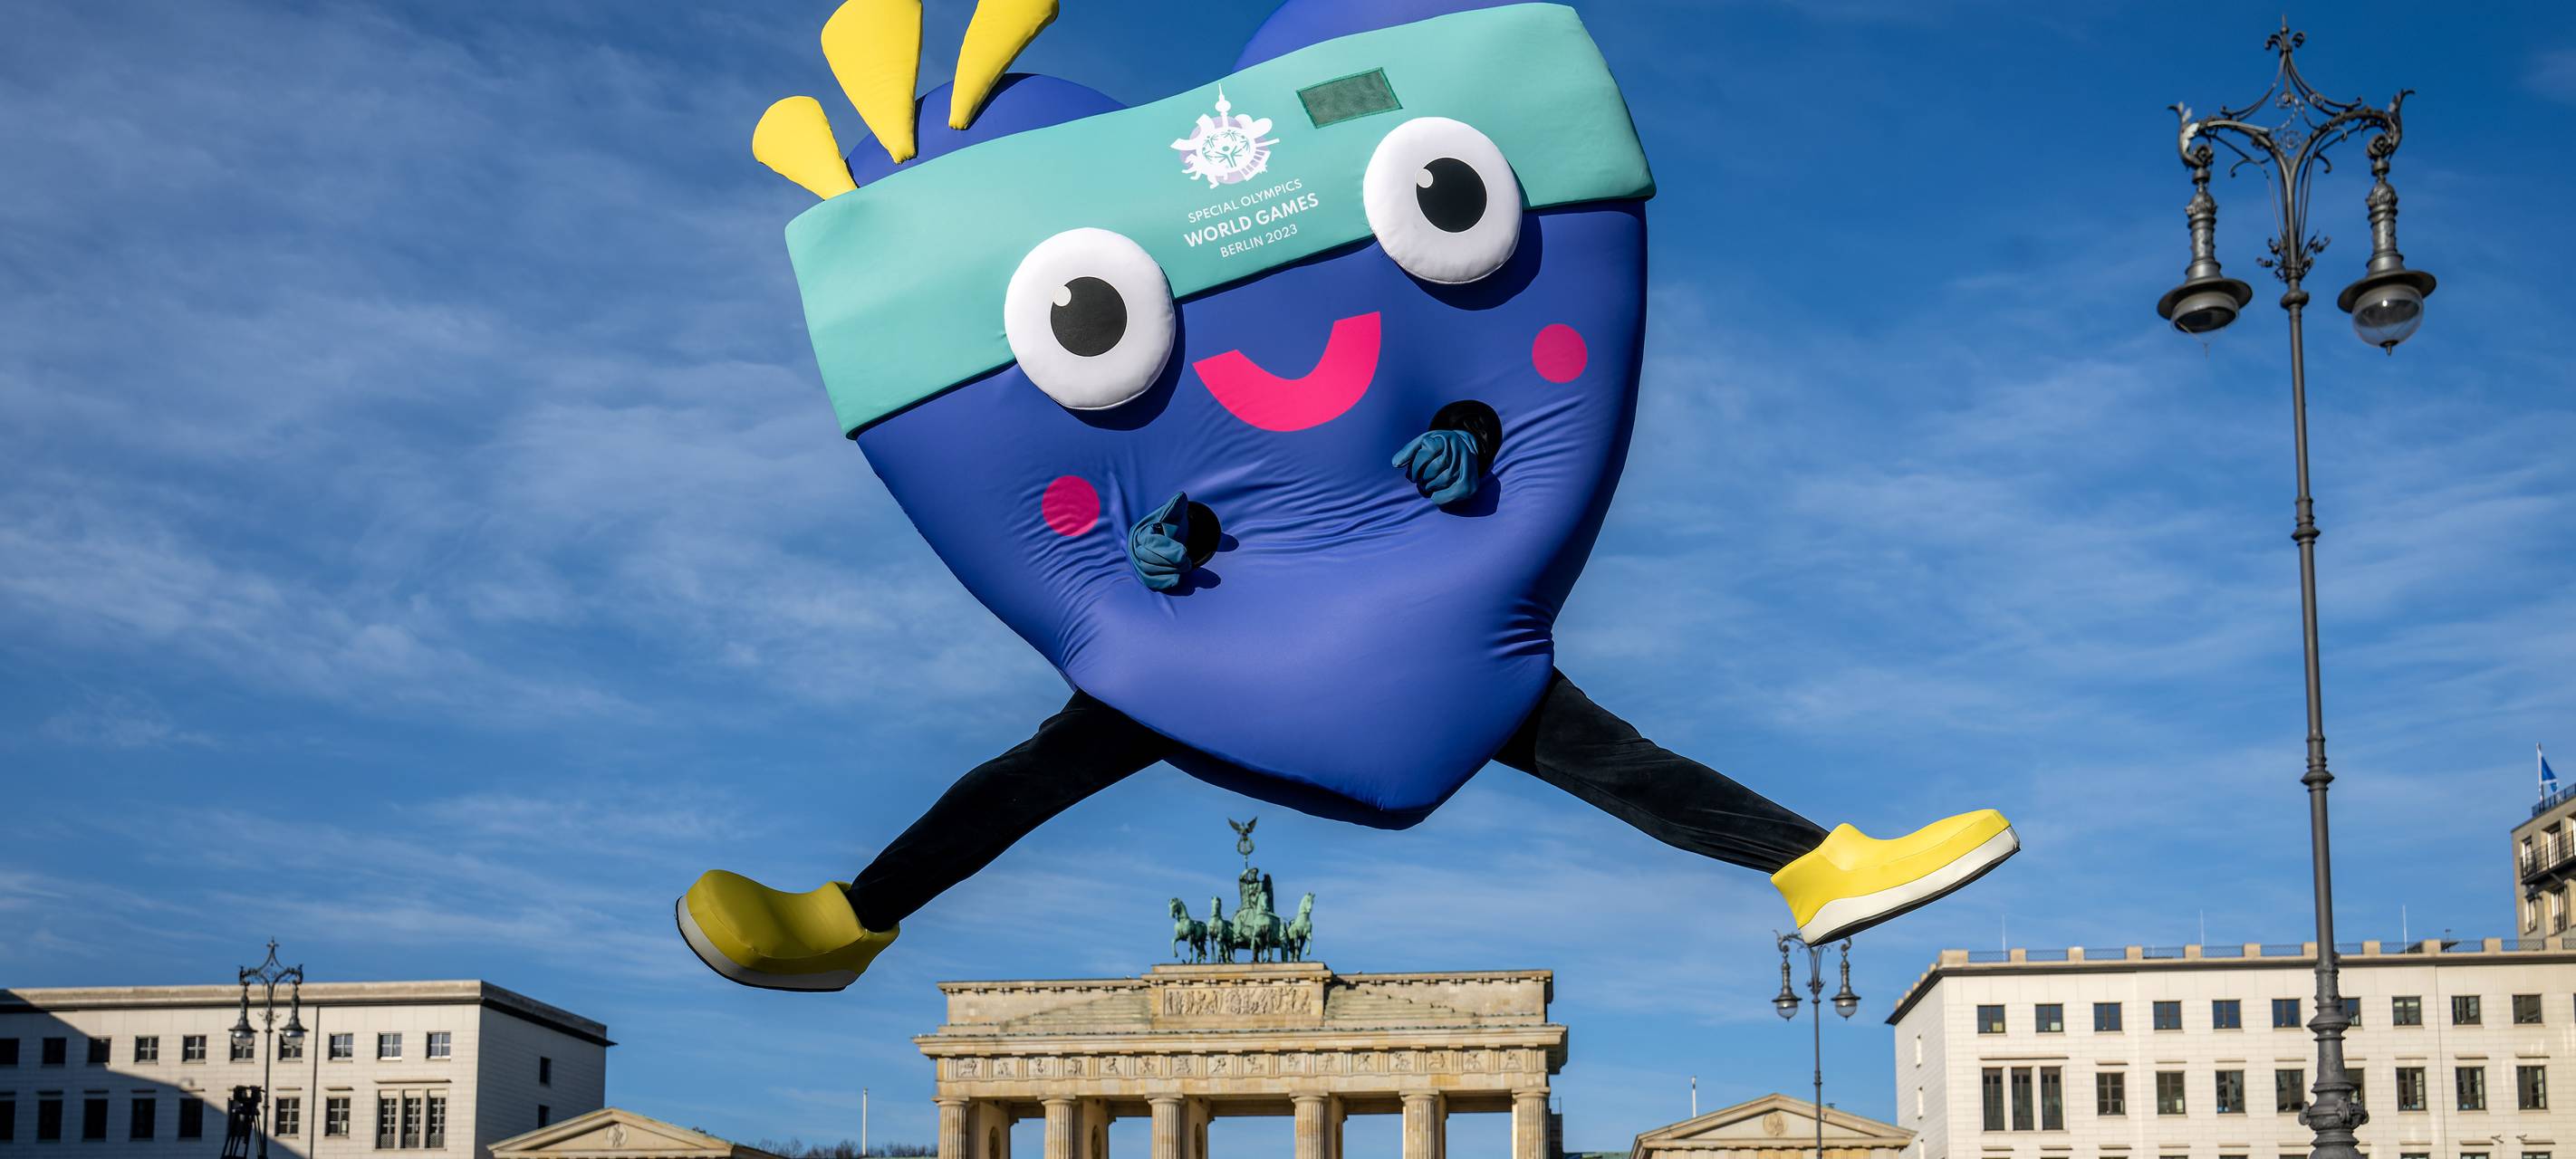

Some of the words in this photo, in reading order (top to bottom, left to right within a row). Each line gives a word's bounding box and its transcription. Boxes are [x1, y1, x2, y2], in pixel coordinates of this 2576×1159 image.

[1183, 216, 1252, 247] WORLD
[1255, 192, 1319, 225] GAMES
[1187, 200, 1240, 224] SPECIAL
[1240, 178, 1302, 206] OLYMPICS
[1220, 235, 1264, 258] BERLIN
[1265, 224, 1298, 244] 2023
